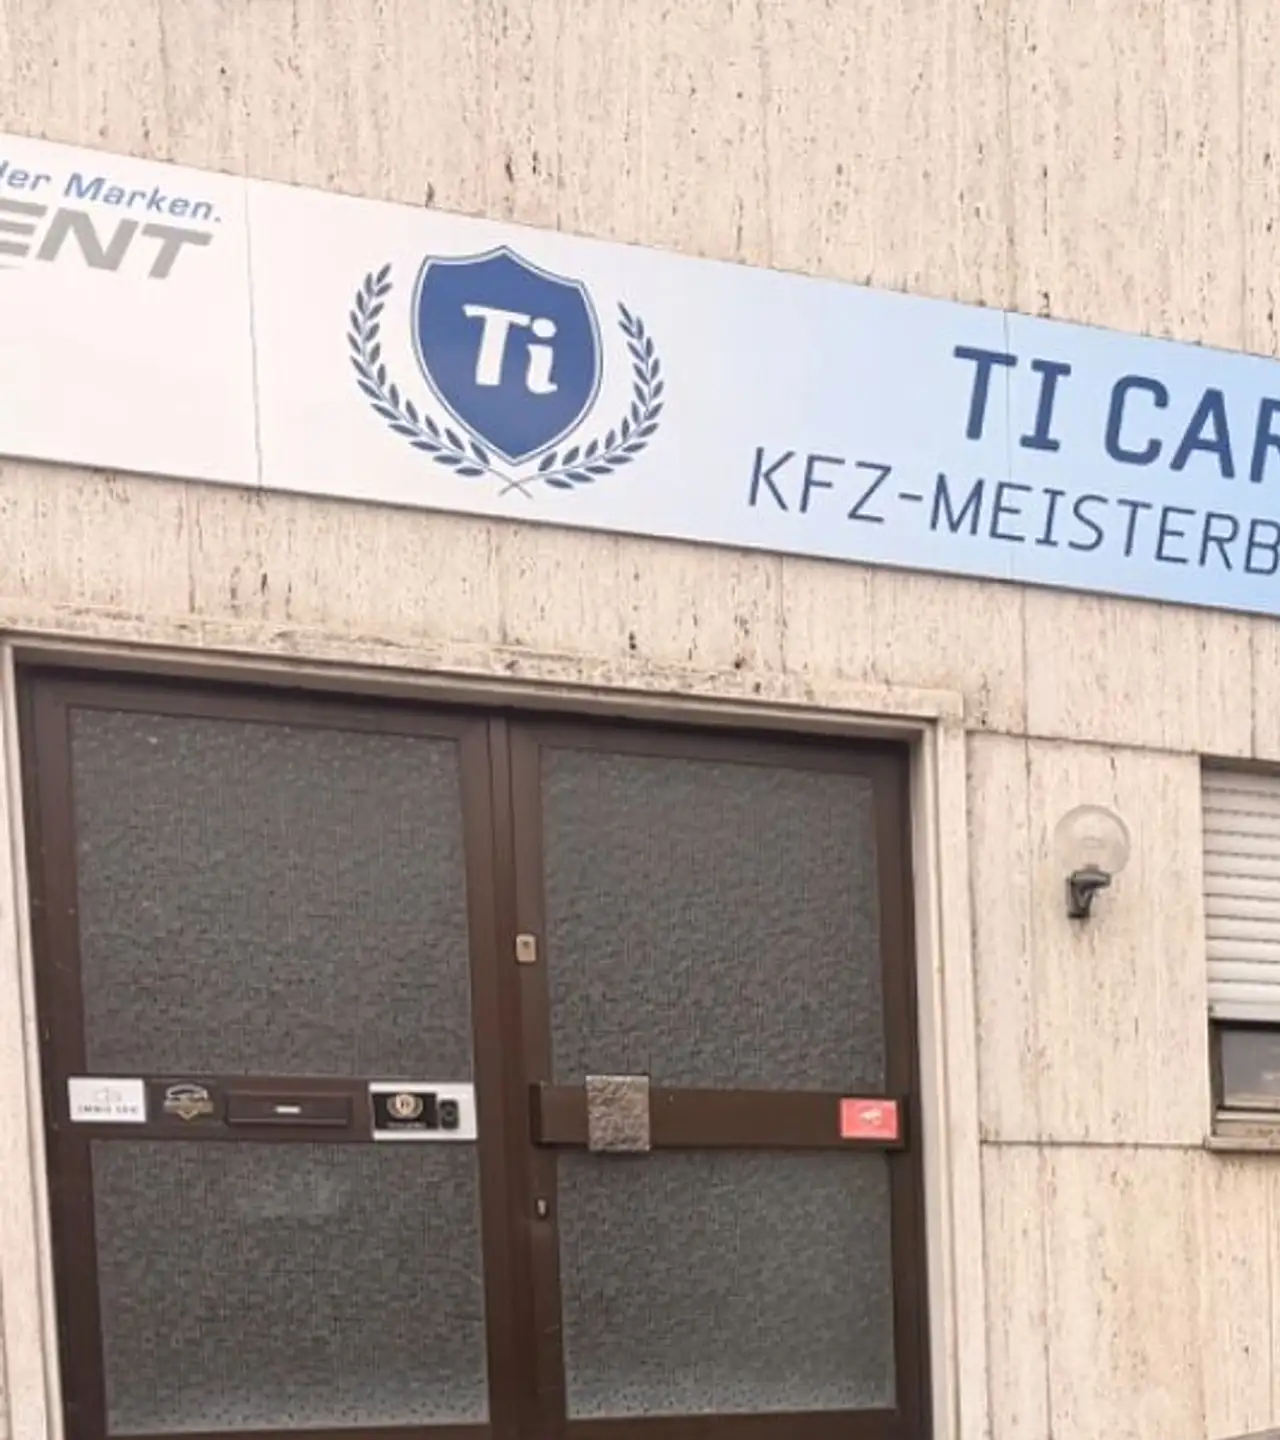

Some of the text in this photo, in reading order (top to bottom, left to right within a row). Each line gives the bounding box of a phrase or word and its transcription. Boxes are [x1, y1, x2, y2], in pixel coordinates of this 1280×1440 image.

[63, 172, 222, 224] Marken.
[462, 303, 558, 395] Ti
[954, 346, 1071, 452] TI
